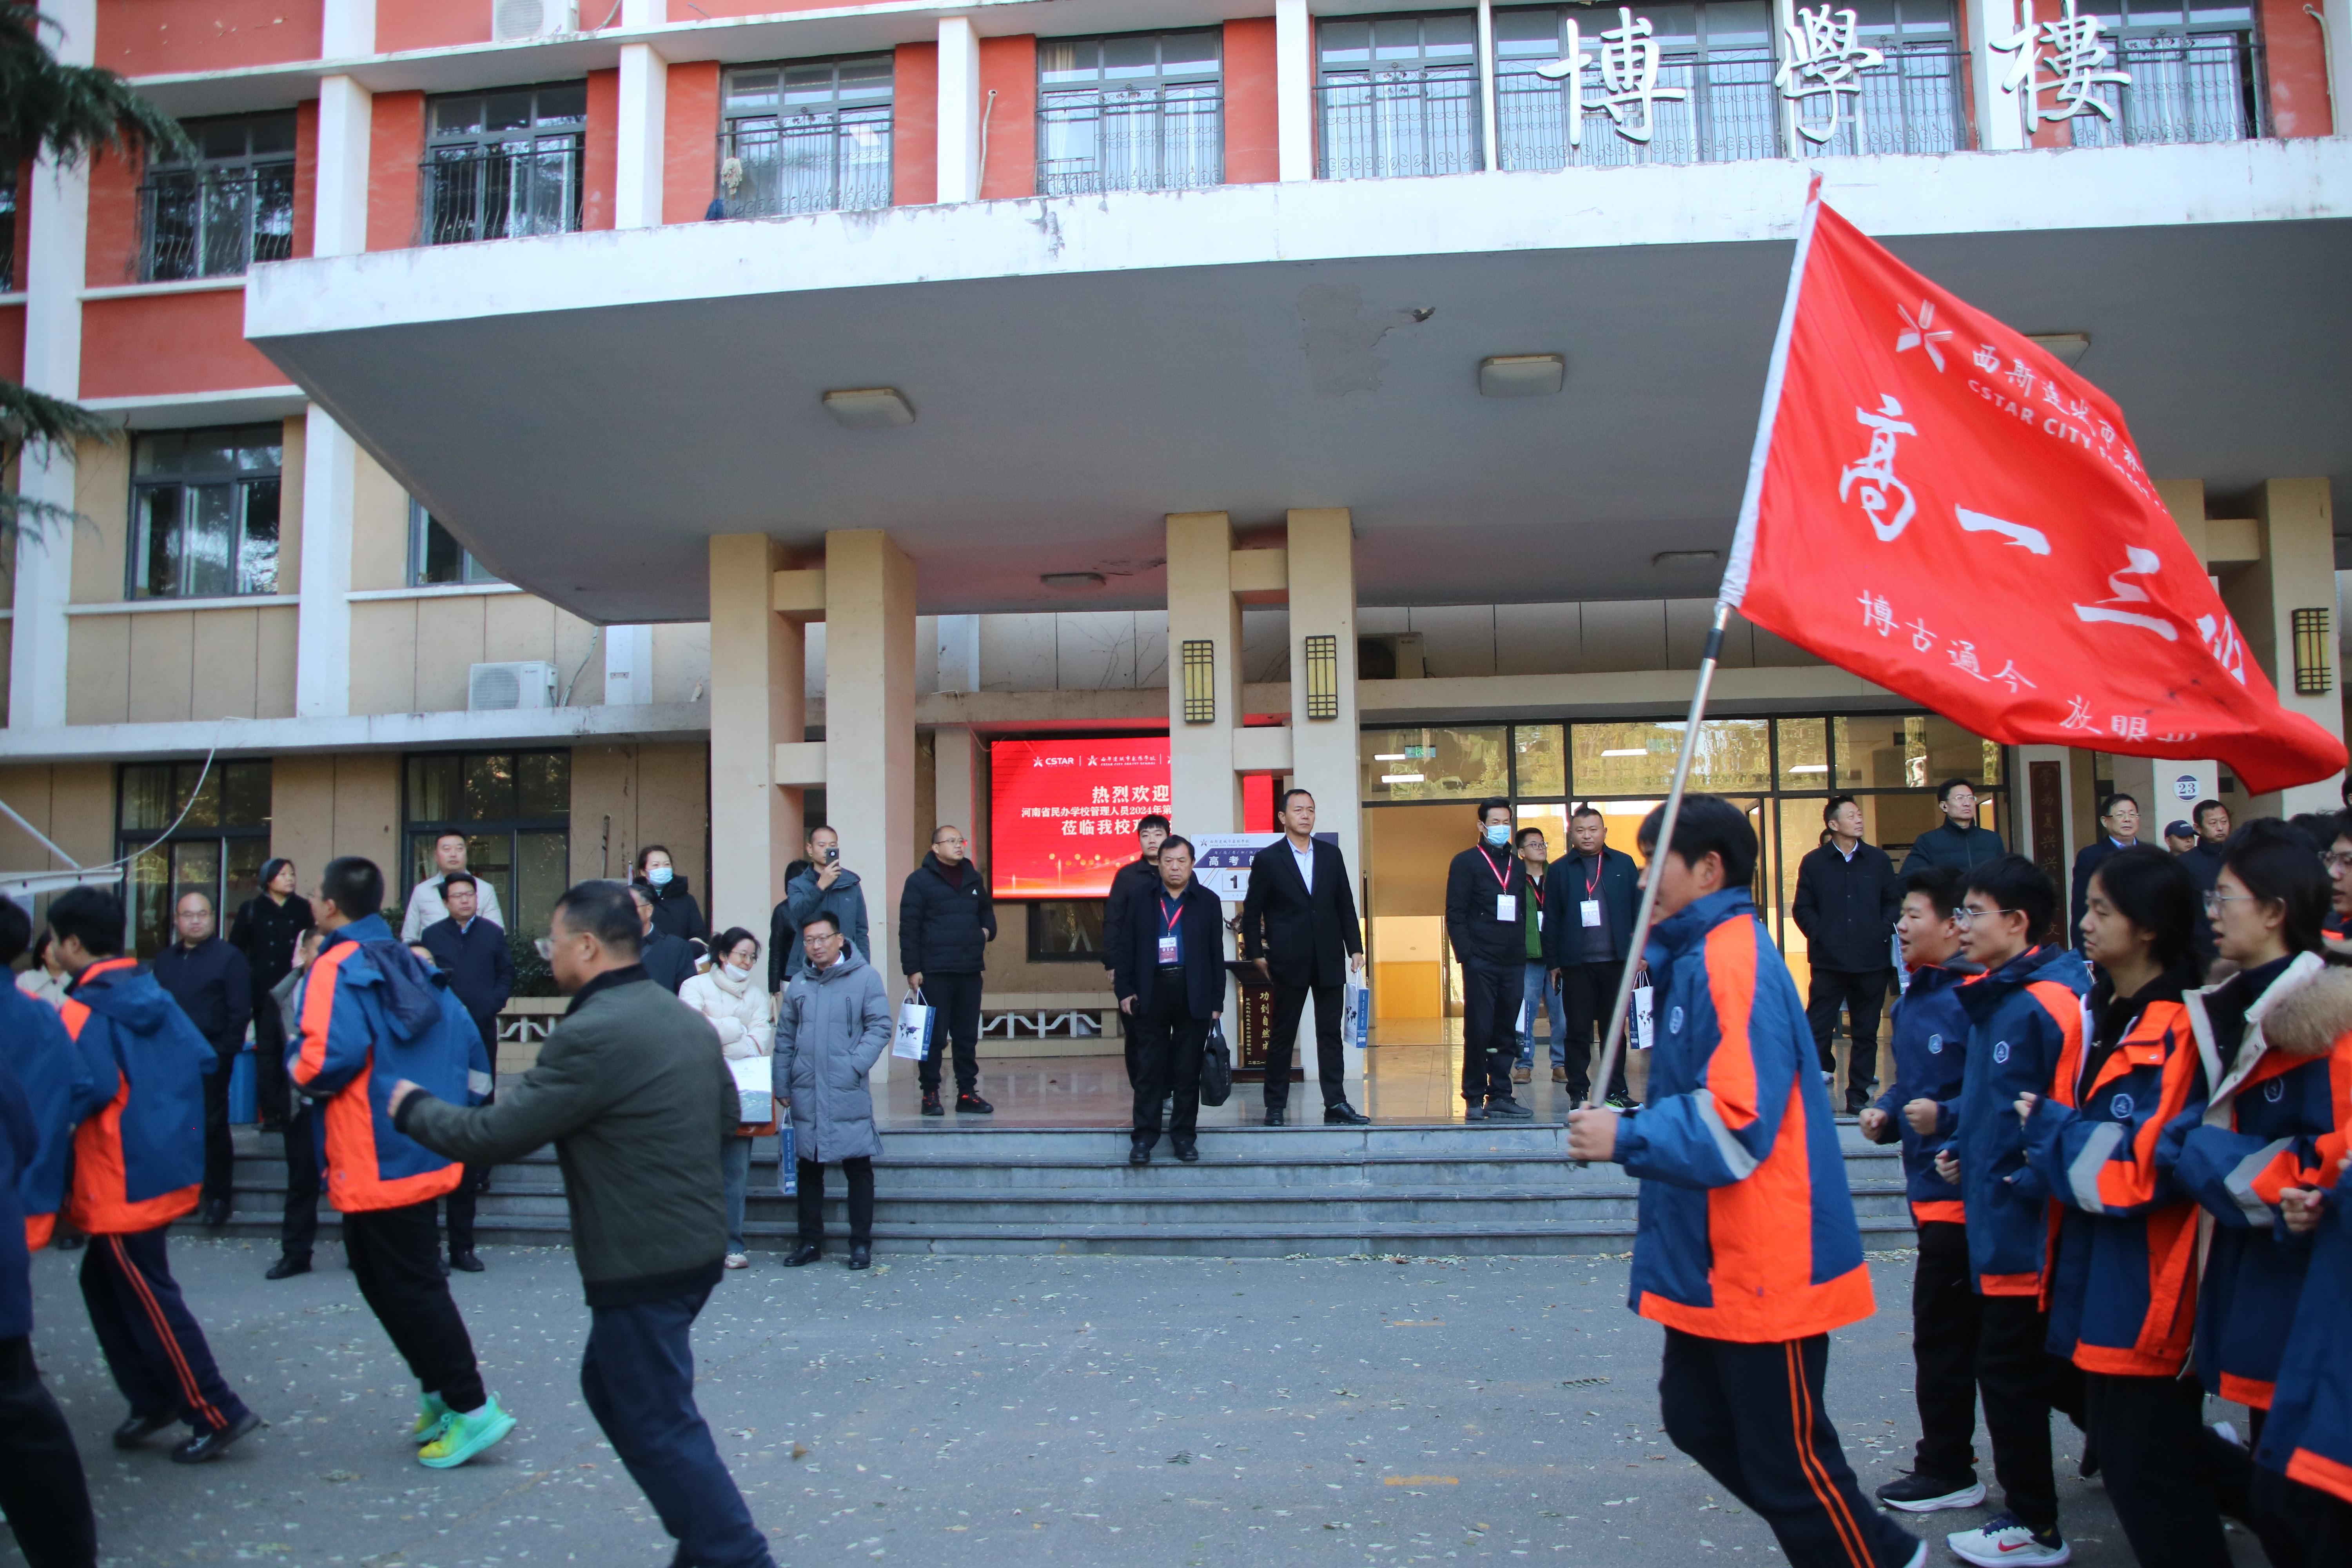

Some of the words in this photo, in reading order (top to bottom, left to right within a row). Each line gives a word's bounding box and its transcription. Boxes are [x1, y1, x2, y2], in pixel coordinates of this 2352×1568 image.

[1536, 0, 2131, 146] 博學樓
[1967, 379, 2034, 425] CSTAR
[2043, 418, 2091, 448] CITY
[1857, 590, 2037, 694] 博古通今
[1092, 785, 1170, 804] 热烈欢迎
[2179, 783, 2195, 794] 23
[1230, 875, 1237, 889] 1
